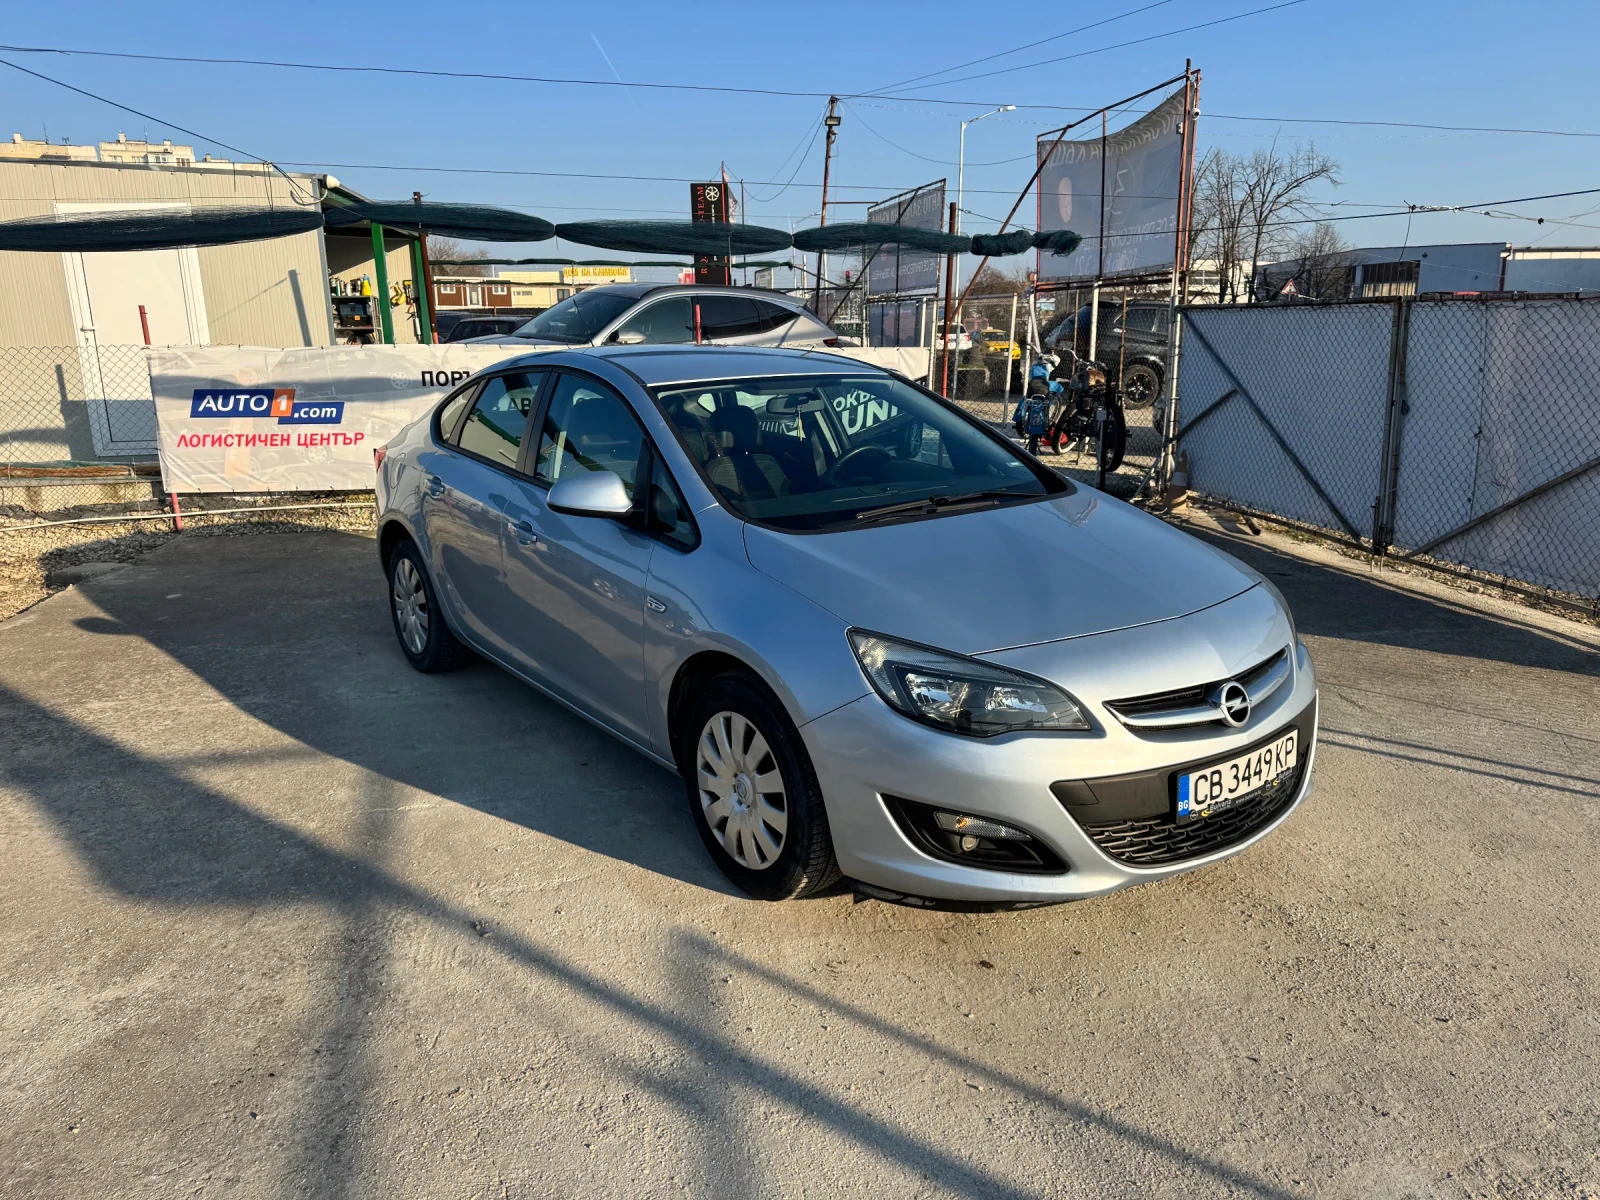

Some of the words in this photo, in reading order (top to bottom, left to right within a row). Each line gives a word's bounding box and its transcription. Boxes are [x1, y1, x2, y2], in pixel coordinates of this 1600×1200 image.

[176, 433, 291, 448] ЛОГИСТИЧЕН
[297, 432, 365, 449] ЦЕНТЪР
[1194, 769, 1224, 806] CB
[1227, 748, 1273, 794] 3449
[1275, 736, 1295, 771] KP
[1178, 799, 1189, 812] BG
